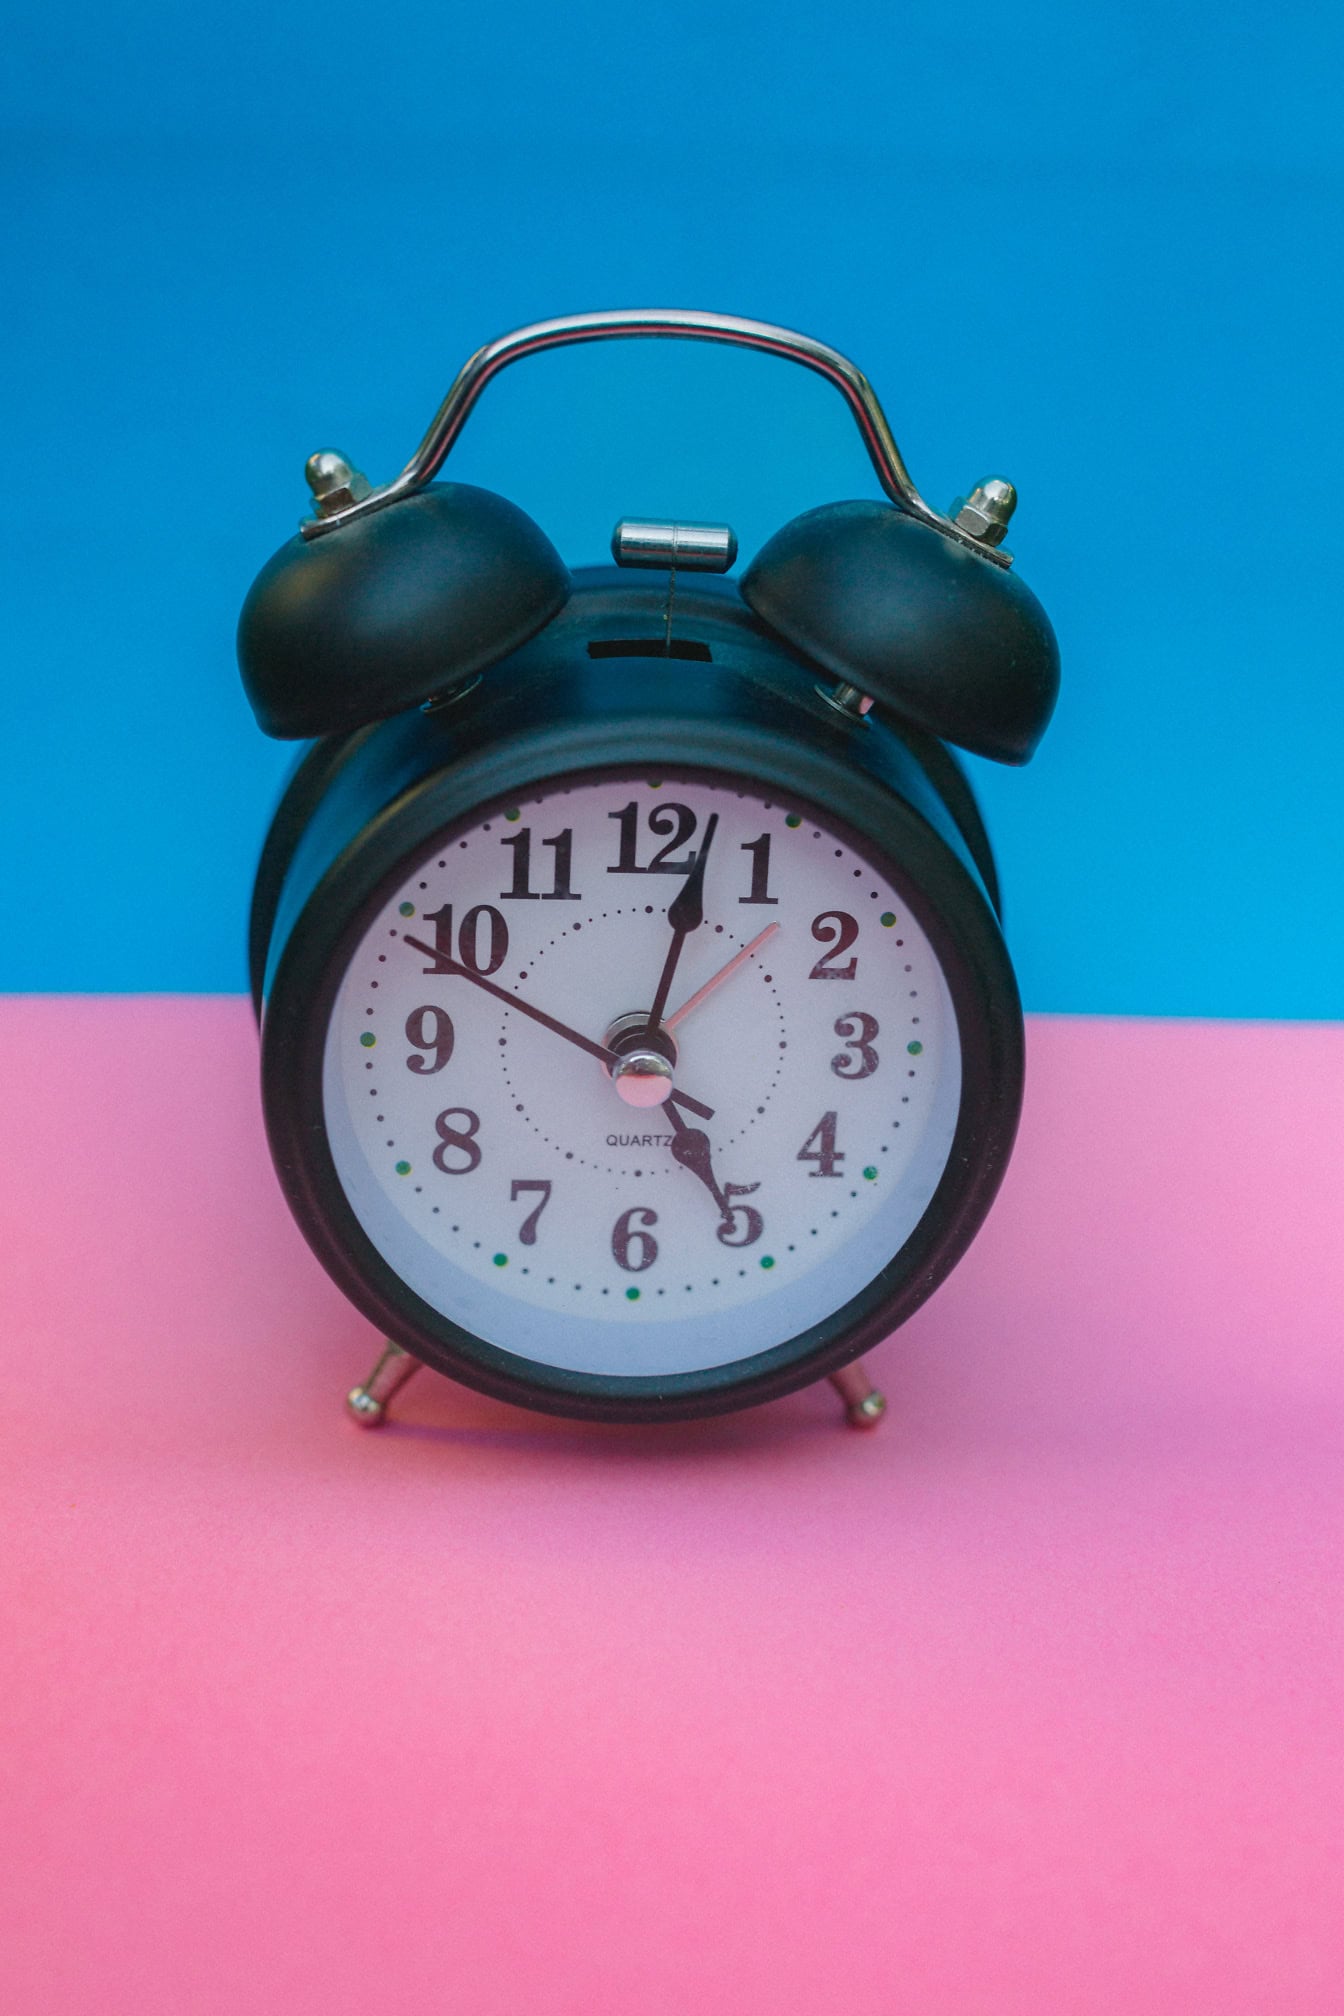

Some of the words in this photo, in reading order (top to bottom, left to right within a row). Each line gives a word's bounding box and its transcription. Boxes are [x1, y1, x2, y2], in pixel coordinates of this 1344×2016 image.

[500, 827, 582, 900] 11
[606, 801, 698, 875] 12
[738, 833, 779, 905] 1
[422, 903, 509, 977] 10
[808, 910, 859, 980] 2
[405, 1005, 455, 1075] 9
[830, 1011, 880, 1080] 3
[432, 1107, 482, 1175] 8
[606, 1134, 674, 1148] QUARTZ
[796, 1111, 845, 1178] 4
[510, 1179, 552, 1246] 7
[611, 1207, 659, 1273] 6
[716, 1181, 764, 1248] 5
